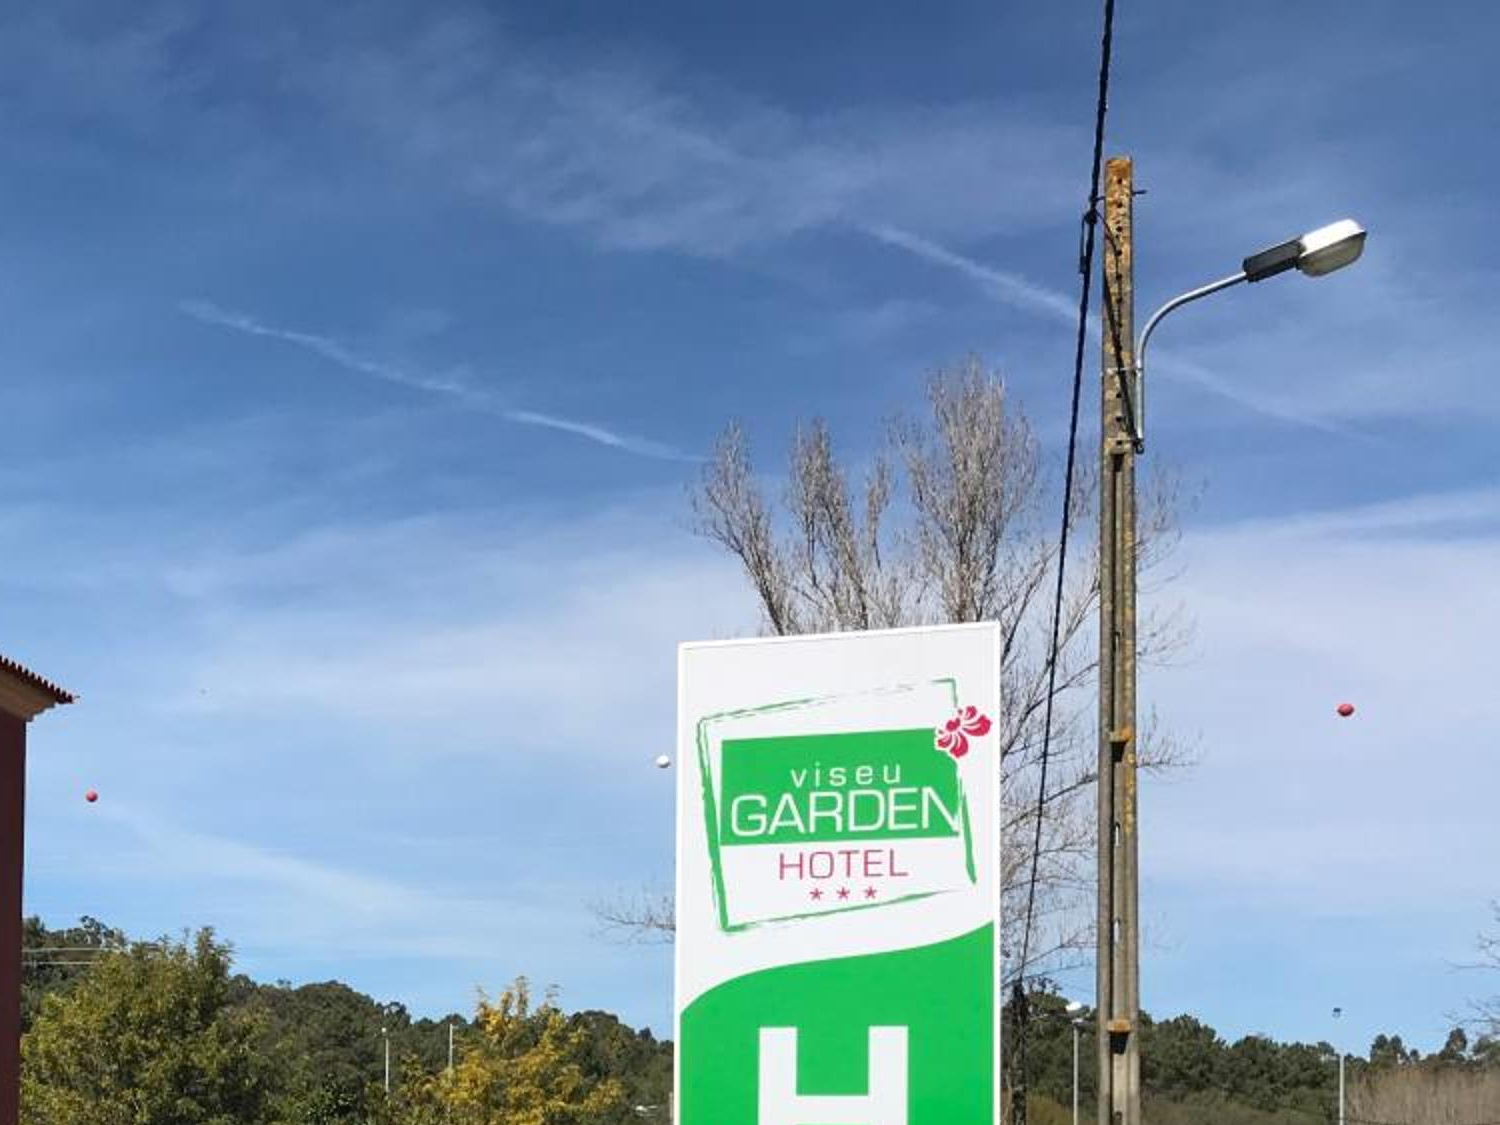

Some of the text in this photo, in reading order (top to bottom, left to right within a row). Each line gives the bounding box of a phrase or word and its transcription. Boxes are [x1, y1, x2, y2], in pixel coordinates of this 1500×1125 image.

[791, 761, 901, 788] viseu
[730, 786, 960, 837] GARDEN
[778, 848, 909, 881] HOTEL
